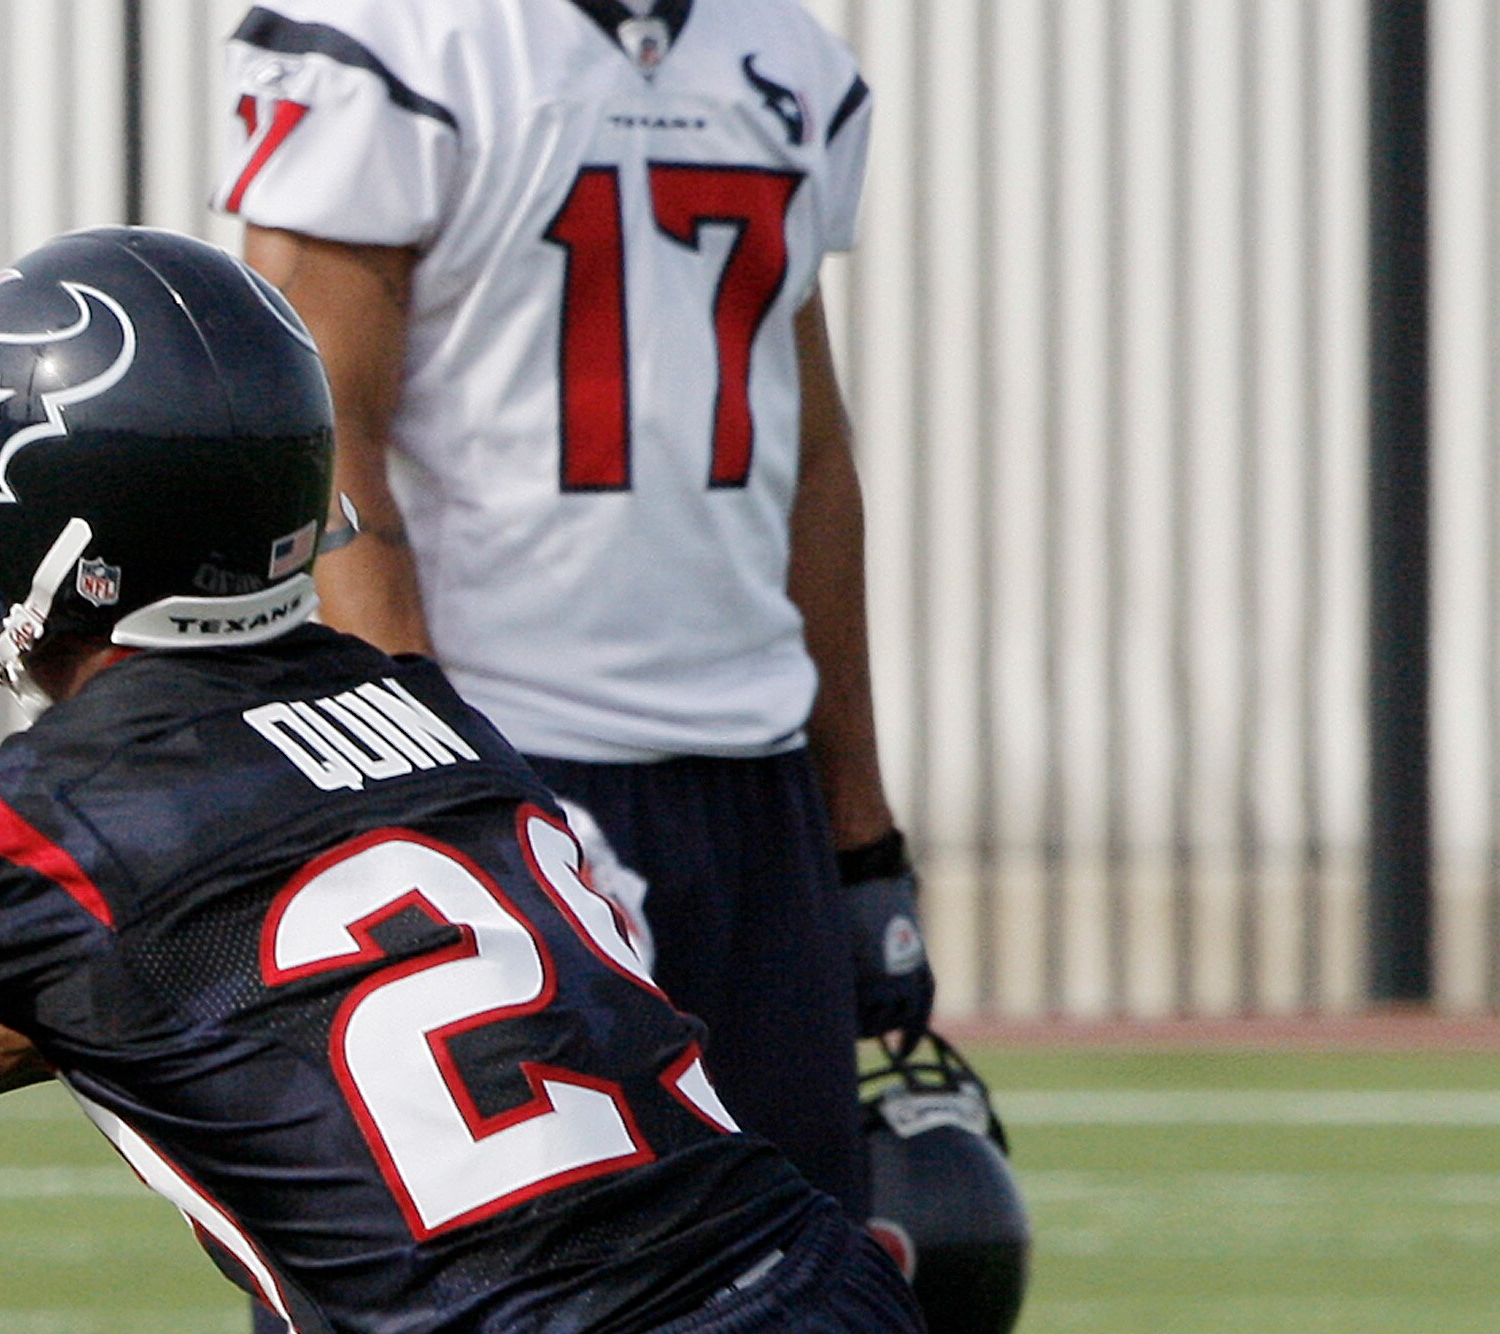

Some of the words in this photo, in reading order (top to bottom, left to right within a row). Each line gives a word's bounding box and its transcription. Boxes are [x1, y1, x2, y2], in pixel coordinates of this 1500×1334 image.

[542, 159, 809, 493] 17
[169, 594, 302, 633] TEXANS
[242, 677, 480, 790] QUIN
